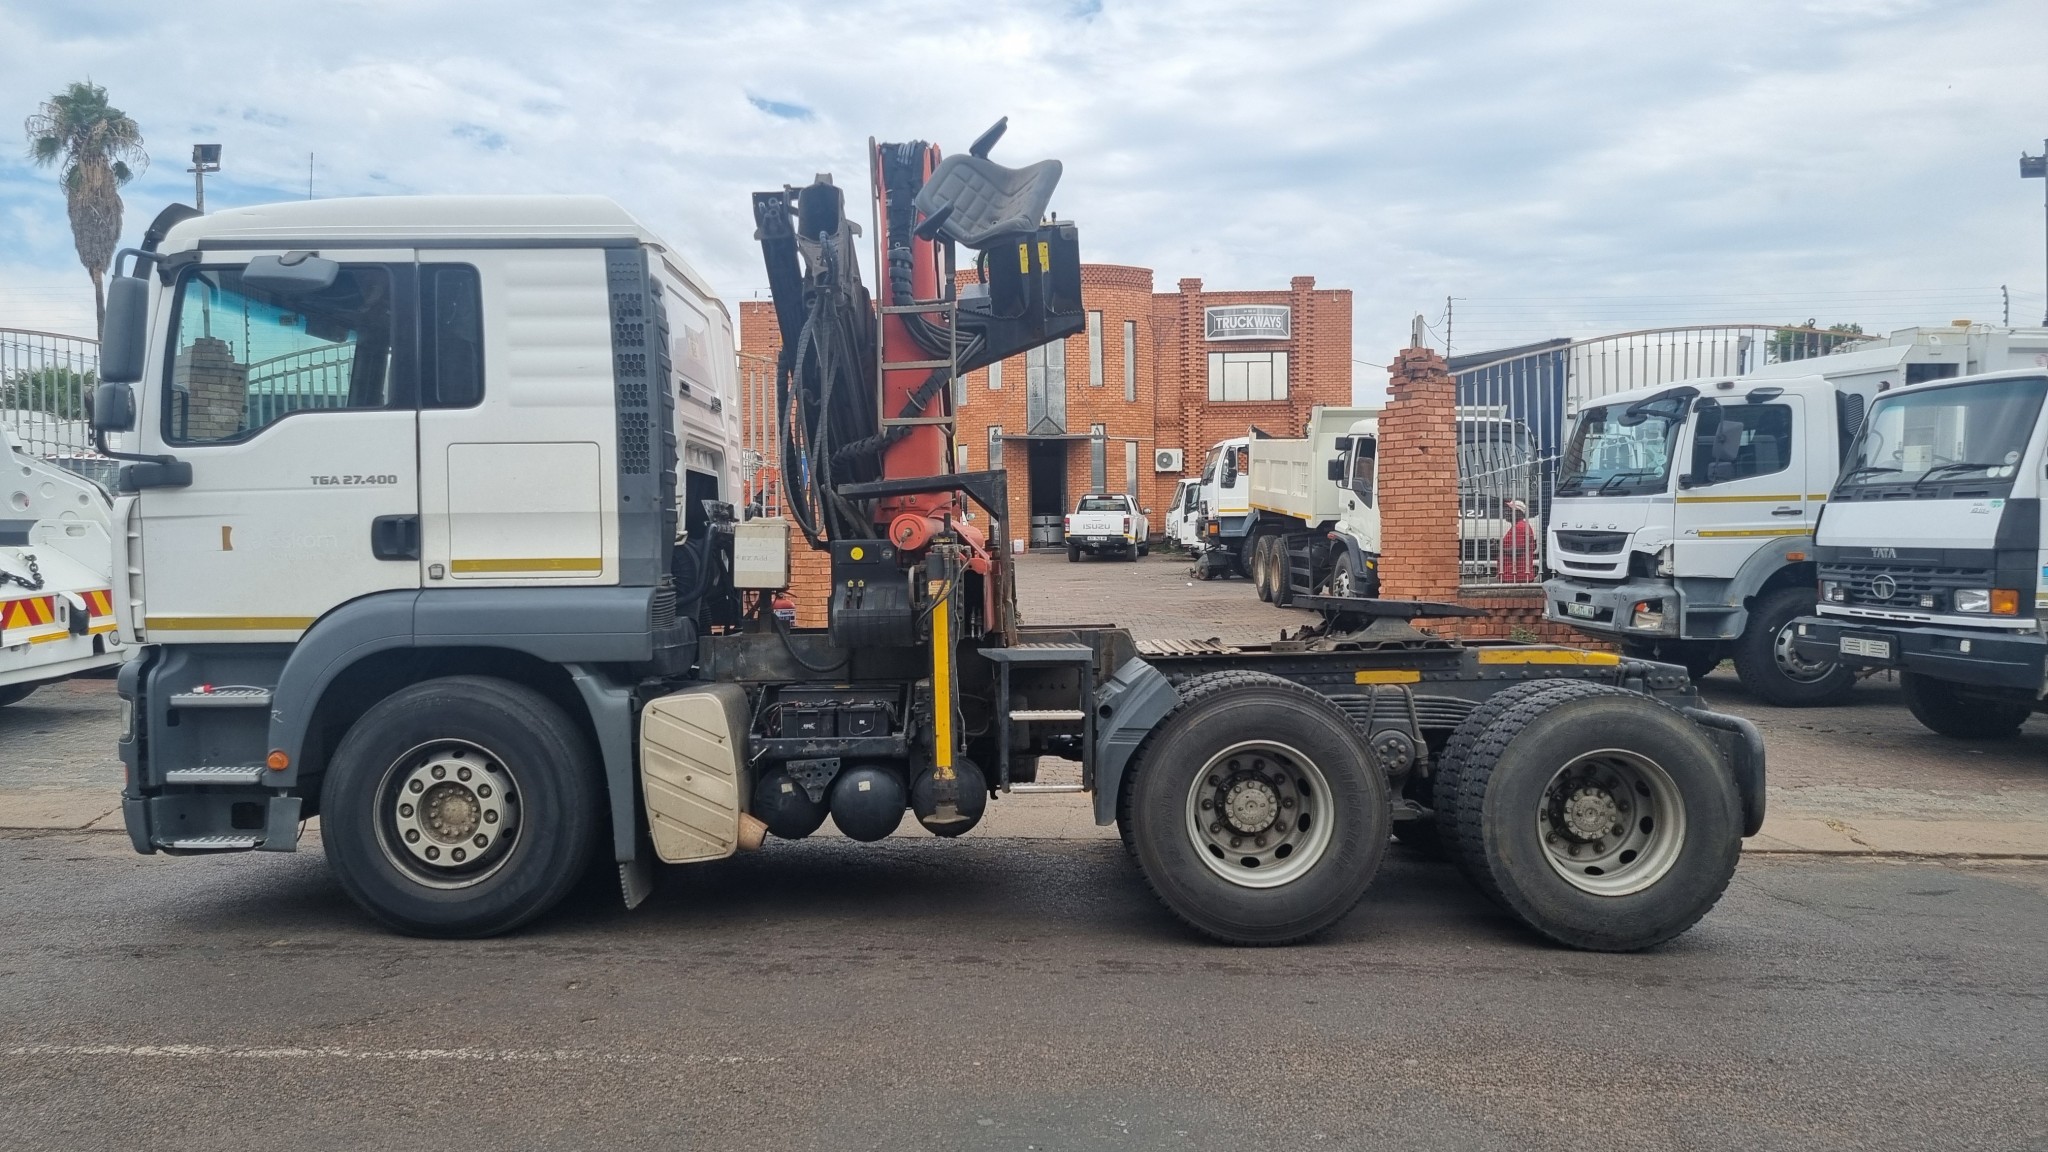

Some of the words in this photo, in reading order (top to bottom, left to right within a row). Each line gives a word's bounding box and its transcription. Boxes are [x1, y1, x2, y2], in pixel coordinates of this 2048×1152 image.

[1215, 315, 1282, 330] TRUCKWAYS
[310, 475, 340, 485] TGA
[343, 474, 398, 485] 27.400
[1561, 522, 1618, 530] FUSO
[1871, 547, 1897, 559] TATA
